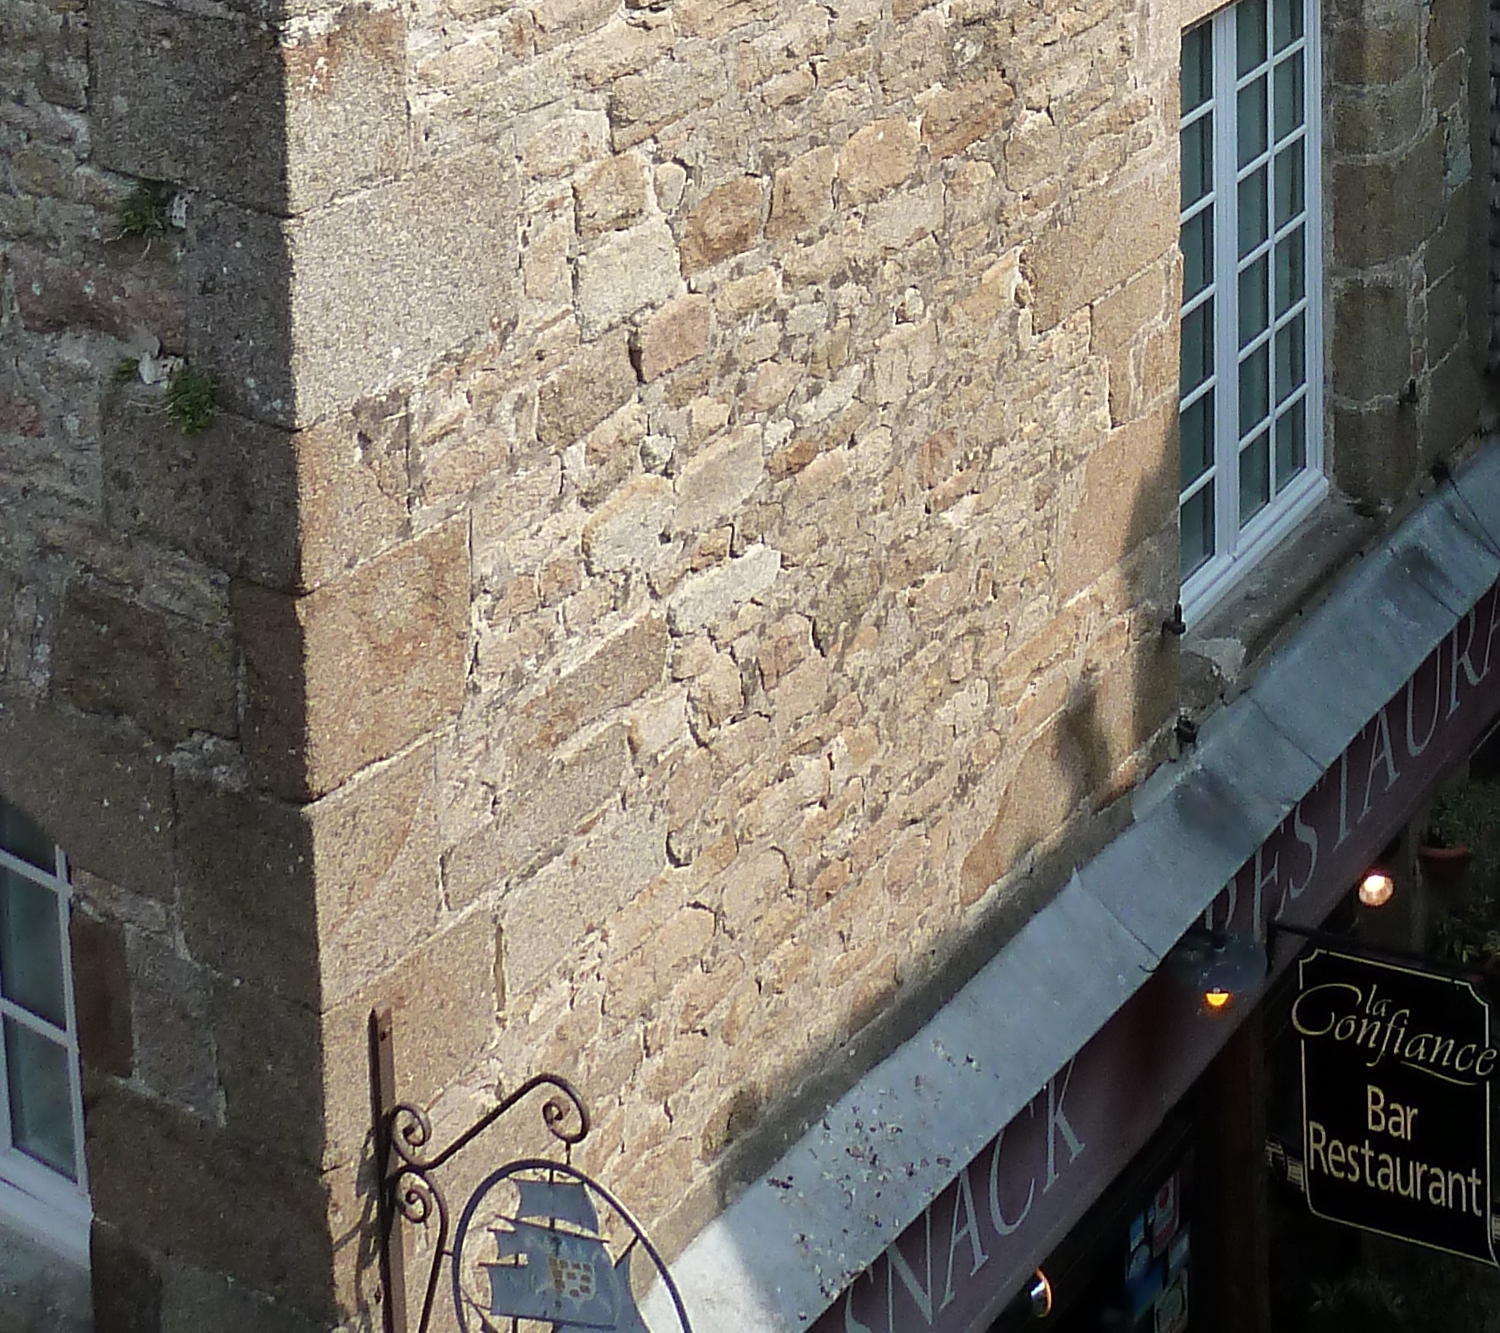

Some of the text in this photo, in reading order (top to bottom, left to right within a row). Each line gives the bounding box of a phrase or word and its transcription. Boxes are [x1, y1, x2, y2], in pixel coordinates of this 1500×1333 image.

[1291, 983, 1498, 1077] Confiance
[1366, 984, 1392, 1016] la
[1367, 1084, 1419, 1142] Bar
[1309, 1121, 1483, 1217] Restaurant
